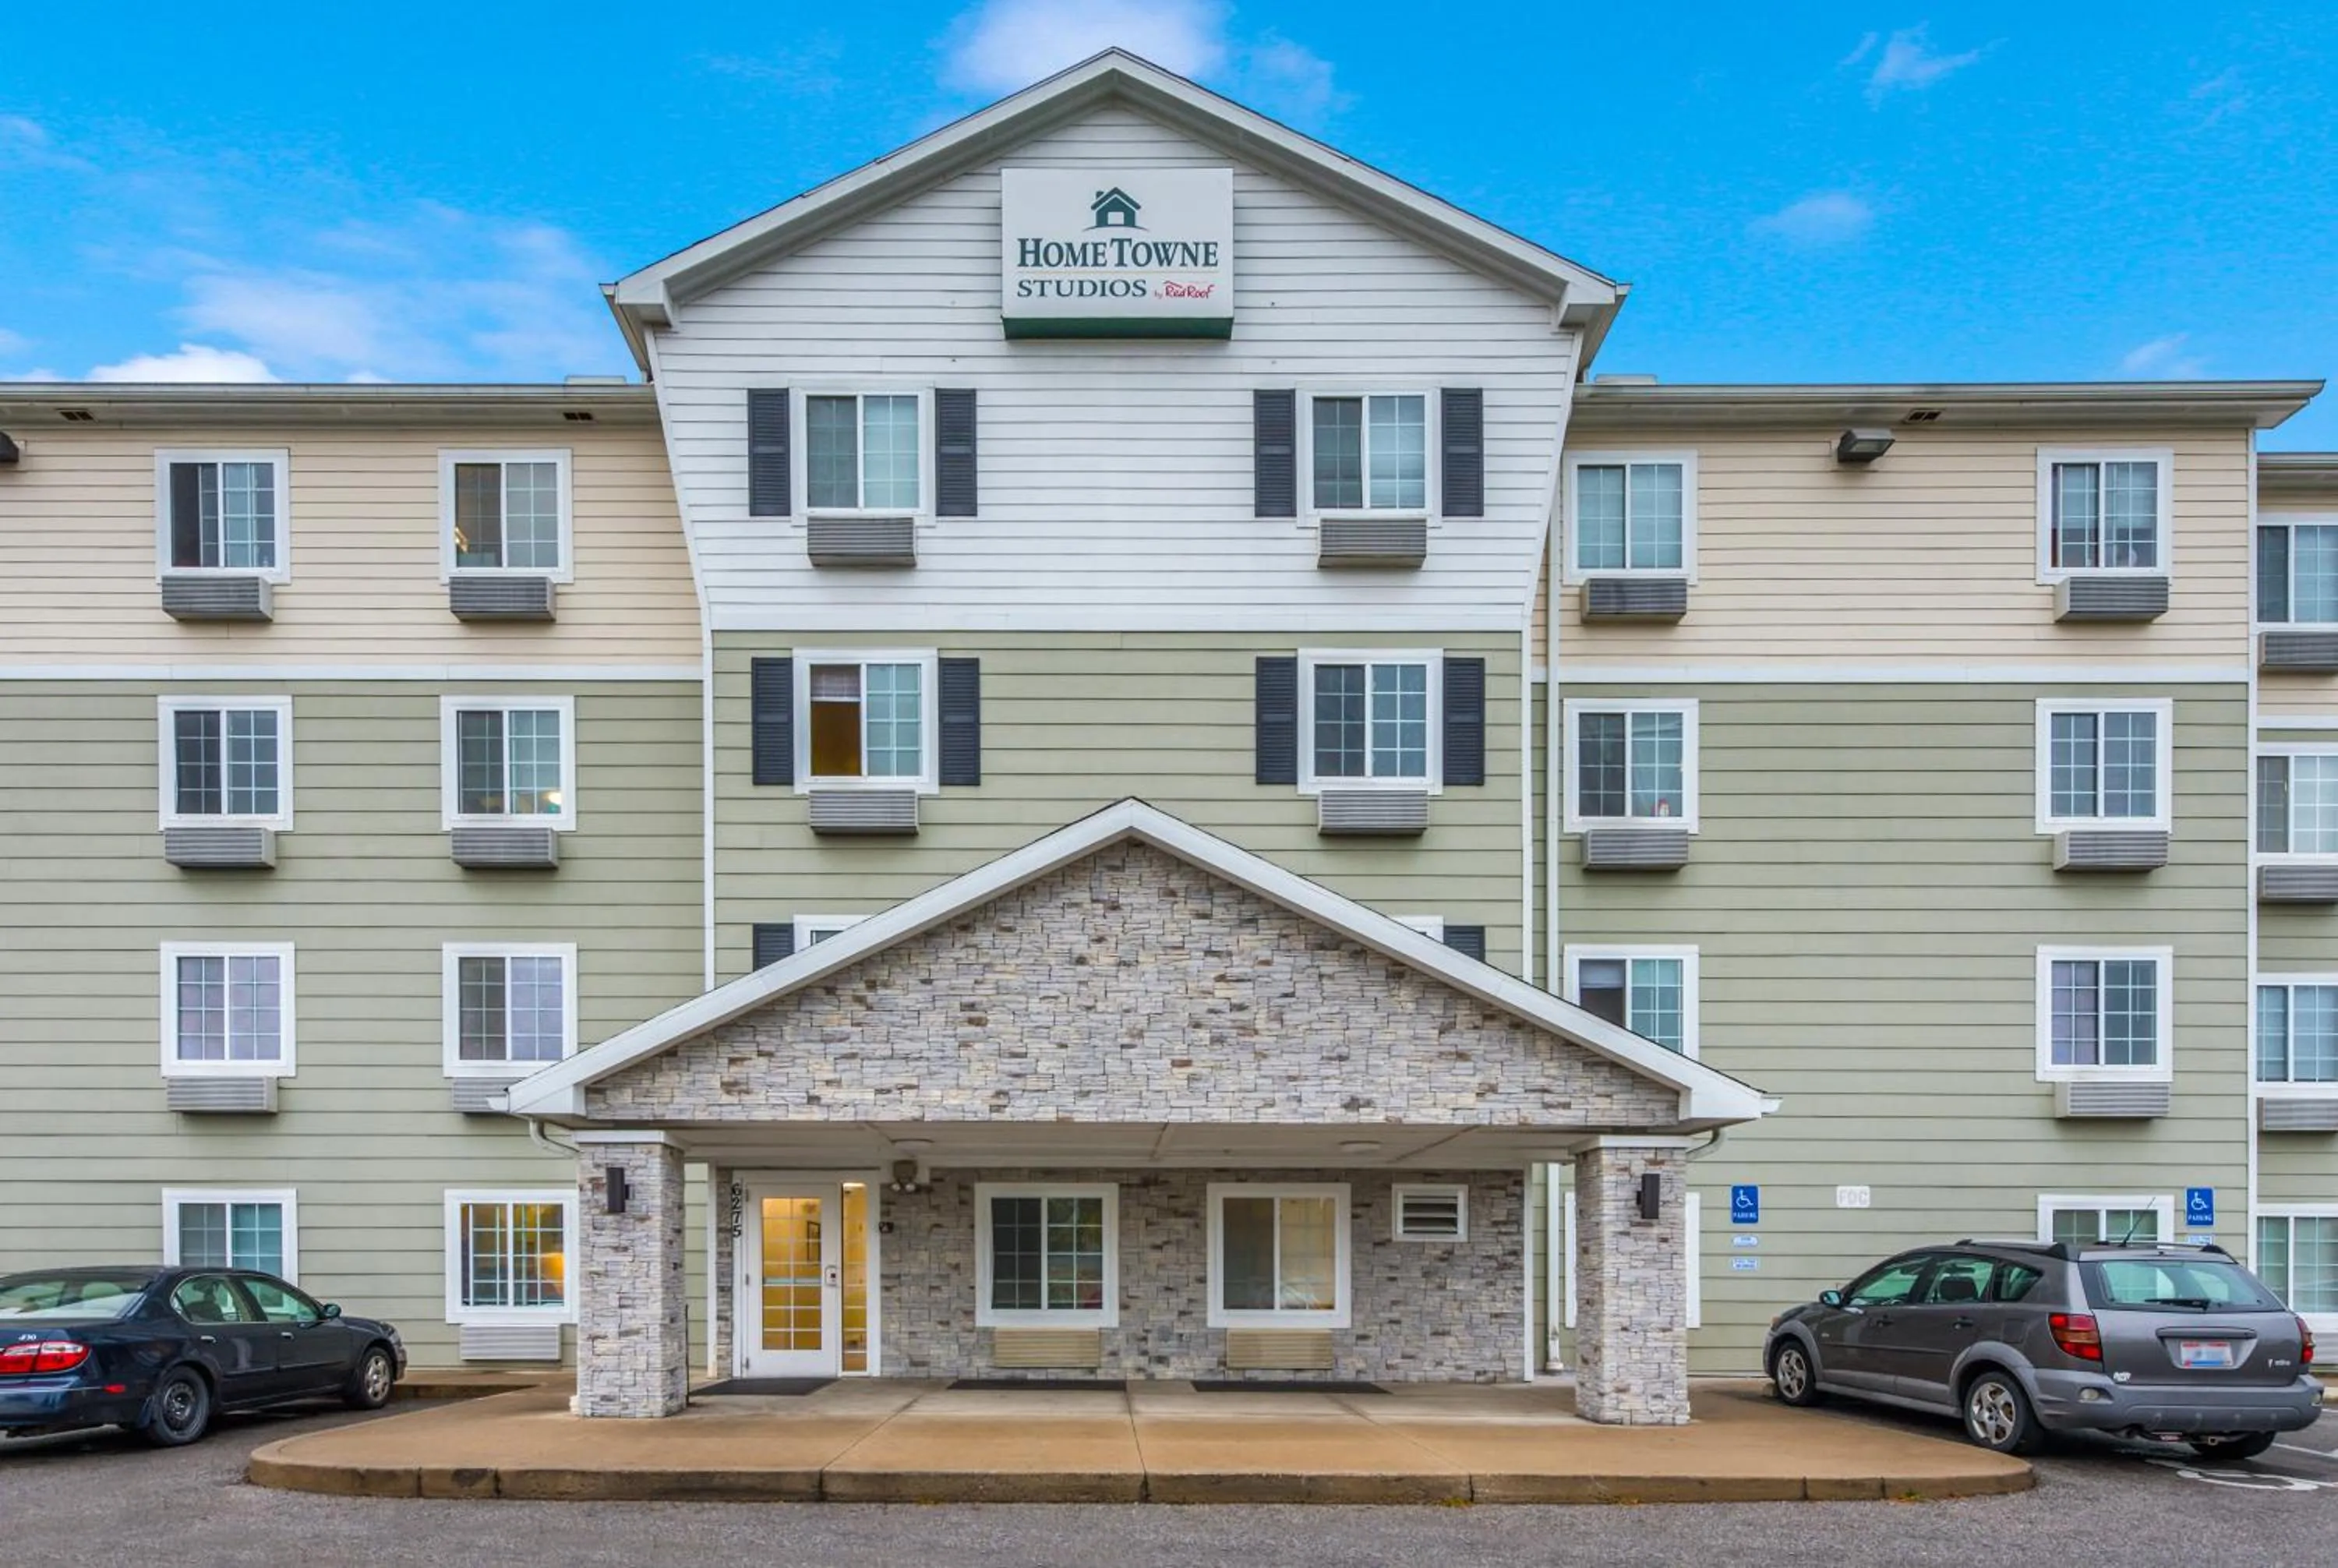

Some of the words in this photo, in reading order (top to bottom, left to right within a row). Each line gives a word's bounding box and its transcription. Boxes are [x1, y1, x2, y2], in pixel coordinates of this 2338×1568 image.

[1016, 238, 1218, 267] HOMETOWNE
[1017, 280, 1146, 298] STUDIOS
[732, 1182, 743, 1238] 6275
